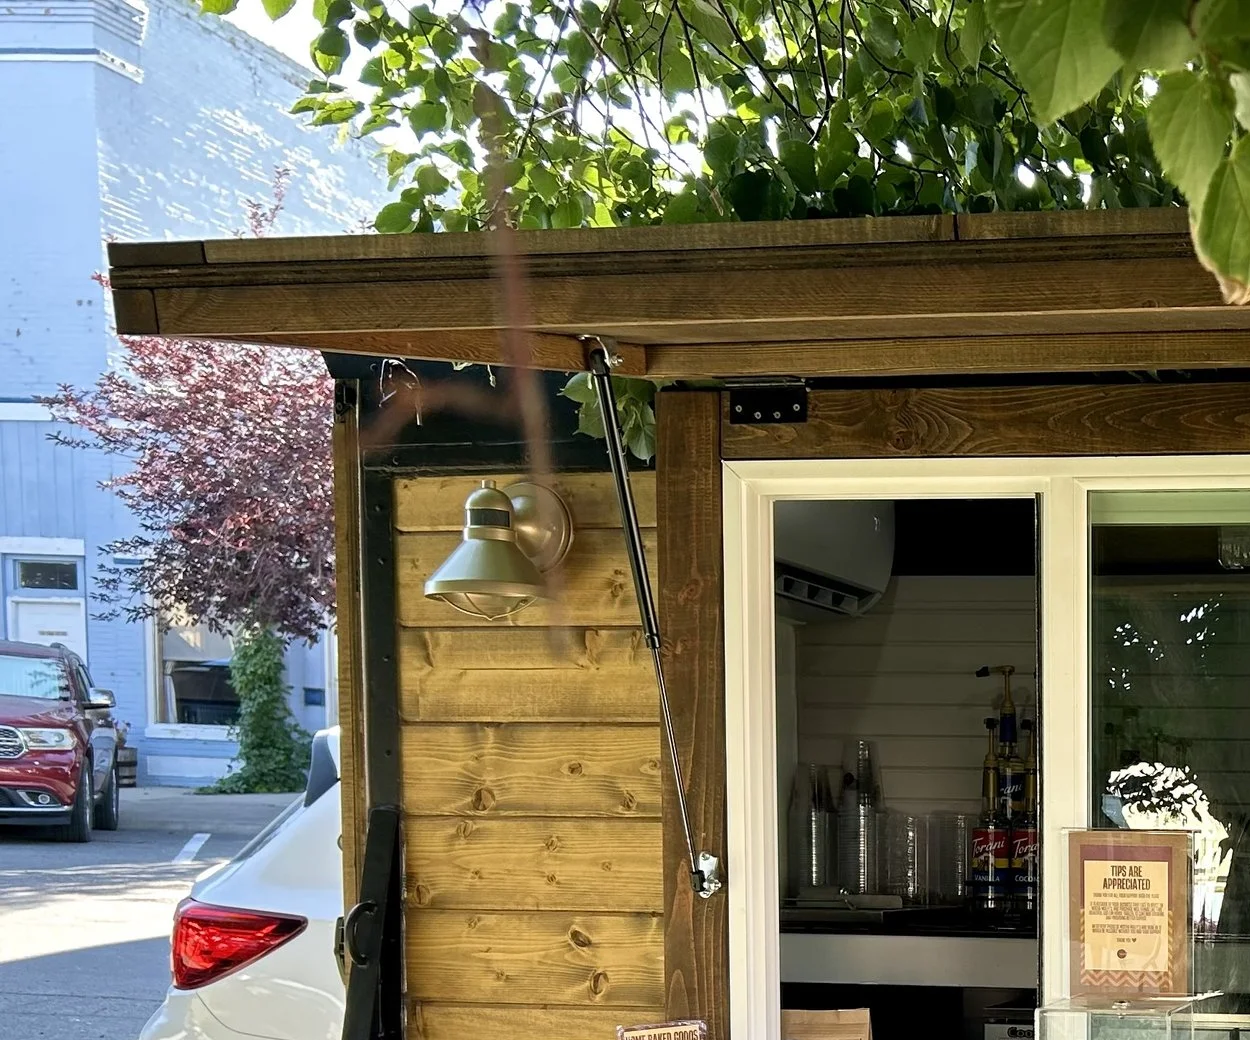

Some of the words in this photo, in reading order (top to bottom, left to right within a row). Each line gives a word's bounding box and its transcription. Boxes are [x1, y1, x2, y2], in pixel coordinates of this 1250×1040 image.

[972, 837, 1005, 857] Torani
[1013, 837, 1038, 858] Tora
[1111, 865, 1126, 877] TIPS
[1129, 866, 1142, 877] ARE
[1103, 878, 1150, 890] APPRECIATED
